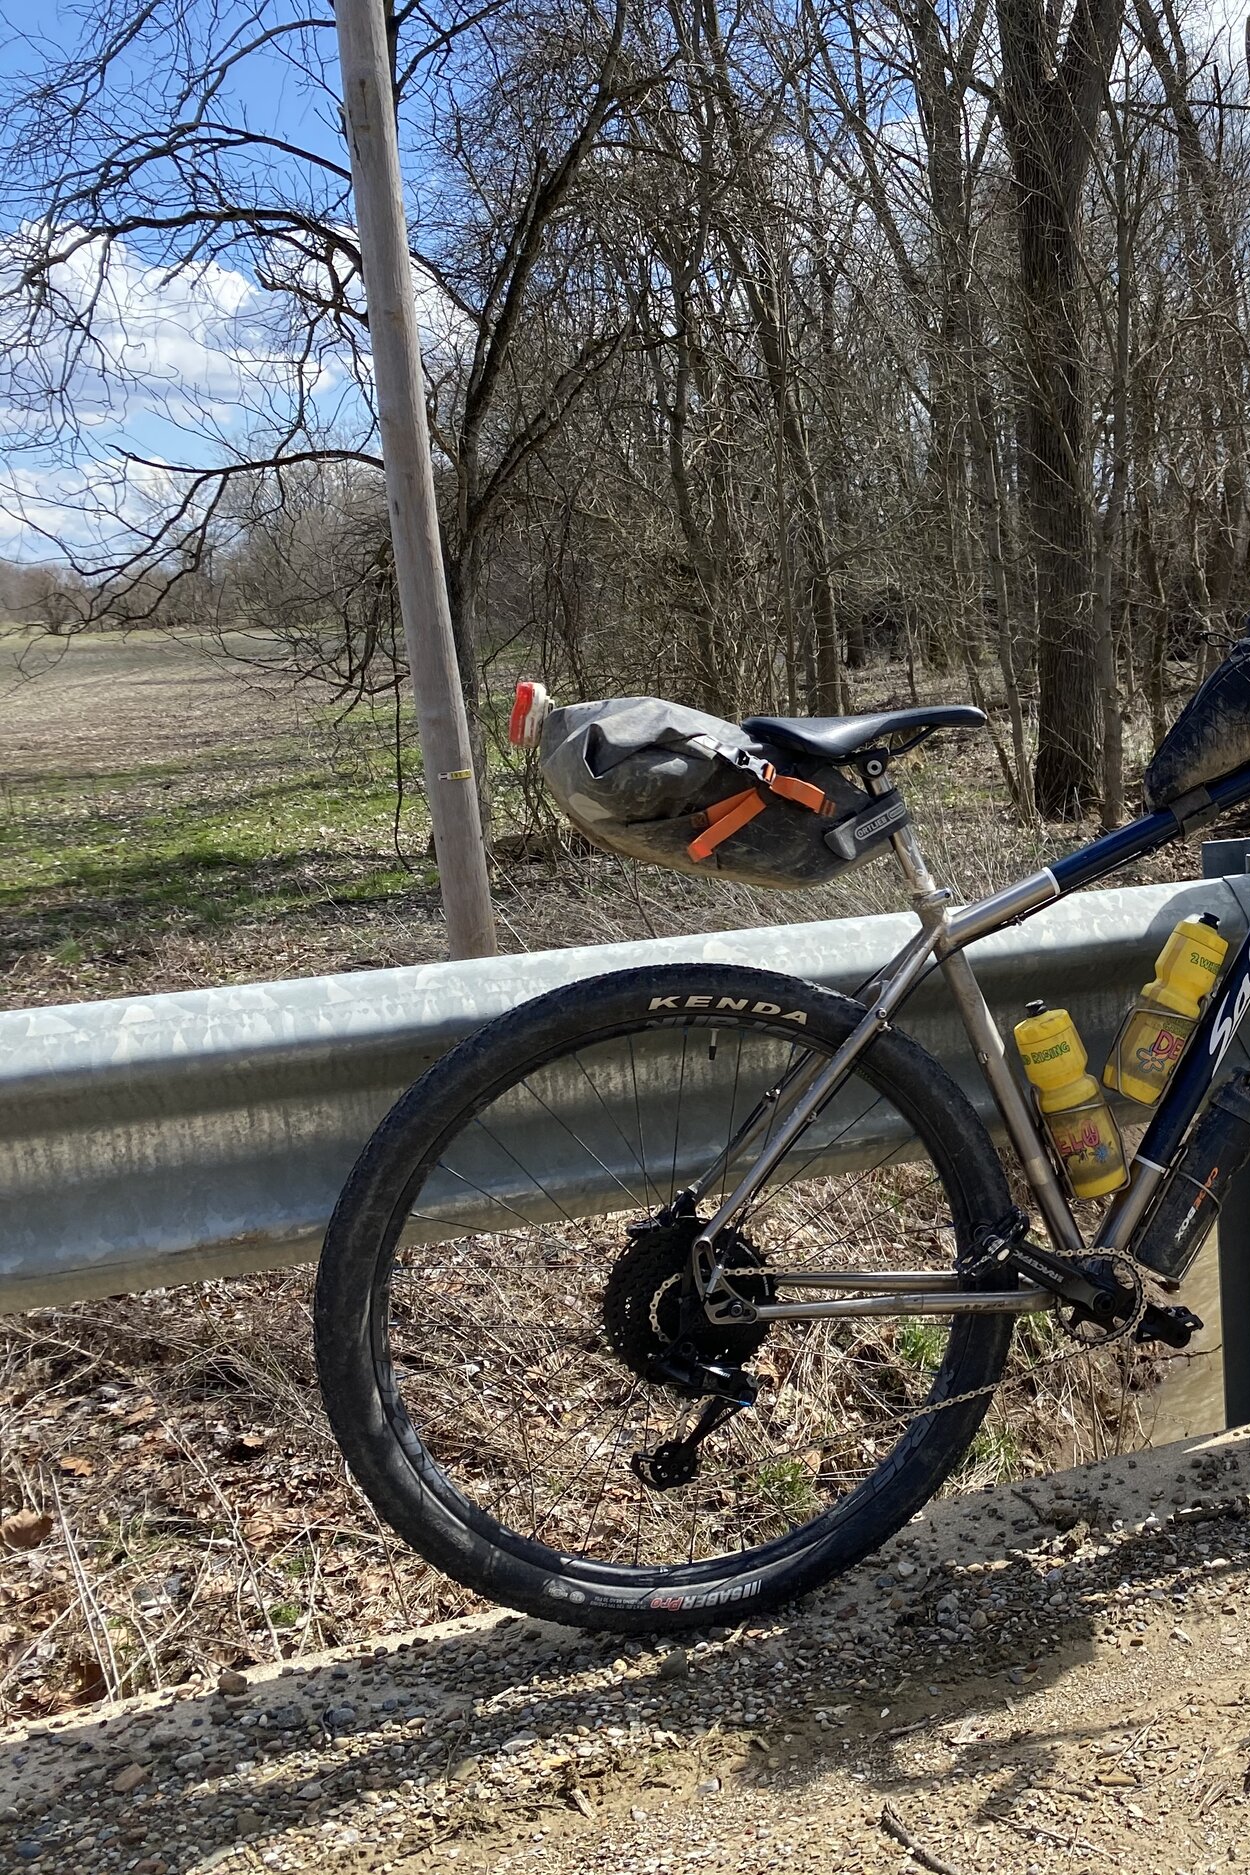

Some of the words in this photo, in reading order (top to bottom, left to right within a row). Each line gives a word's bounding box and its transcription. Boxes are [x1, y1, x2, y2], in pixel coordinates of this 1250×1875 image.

[857, 816, 888, 838] ORTLIEB
[1190, 952, 1199, 964] 2
[648, 995, 808, 1025] KENDA
[1031, 1041, 1070, 1064] RISING
[1013, 1249, 1061, 1282] RACEFAC
